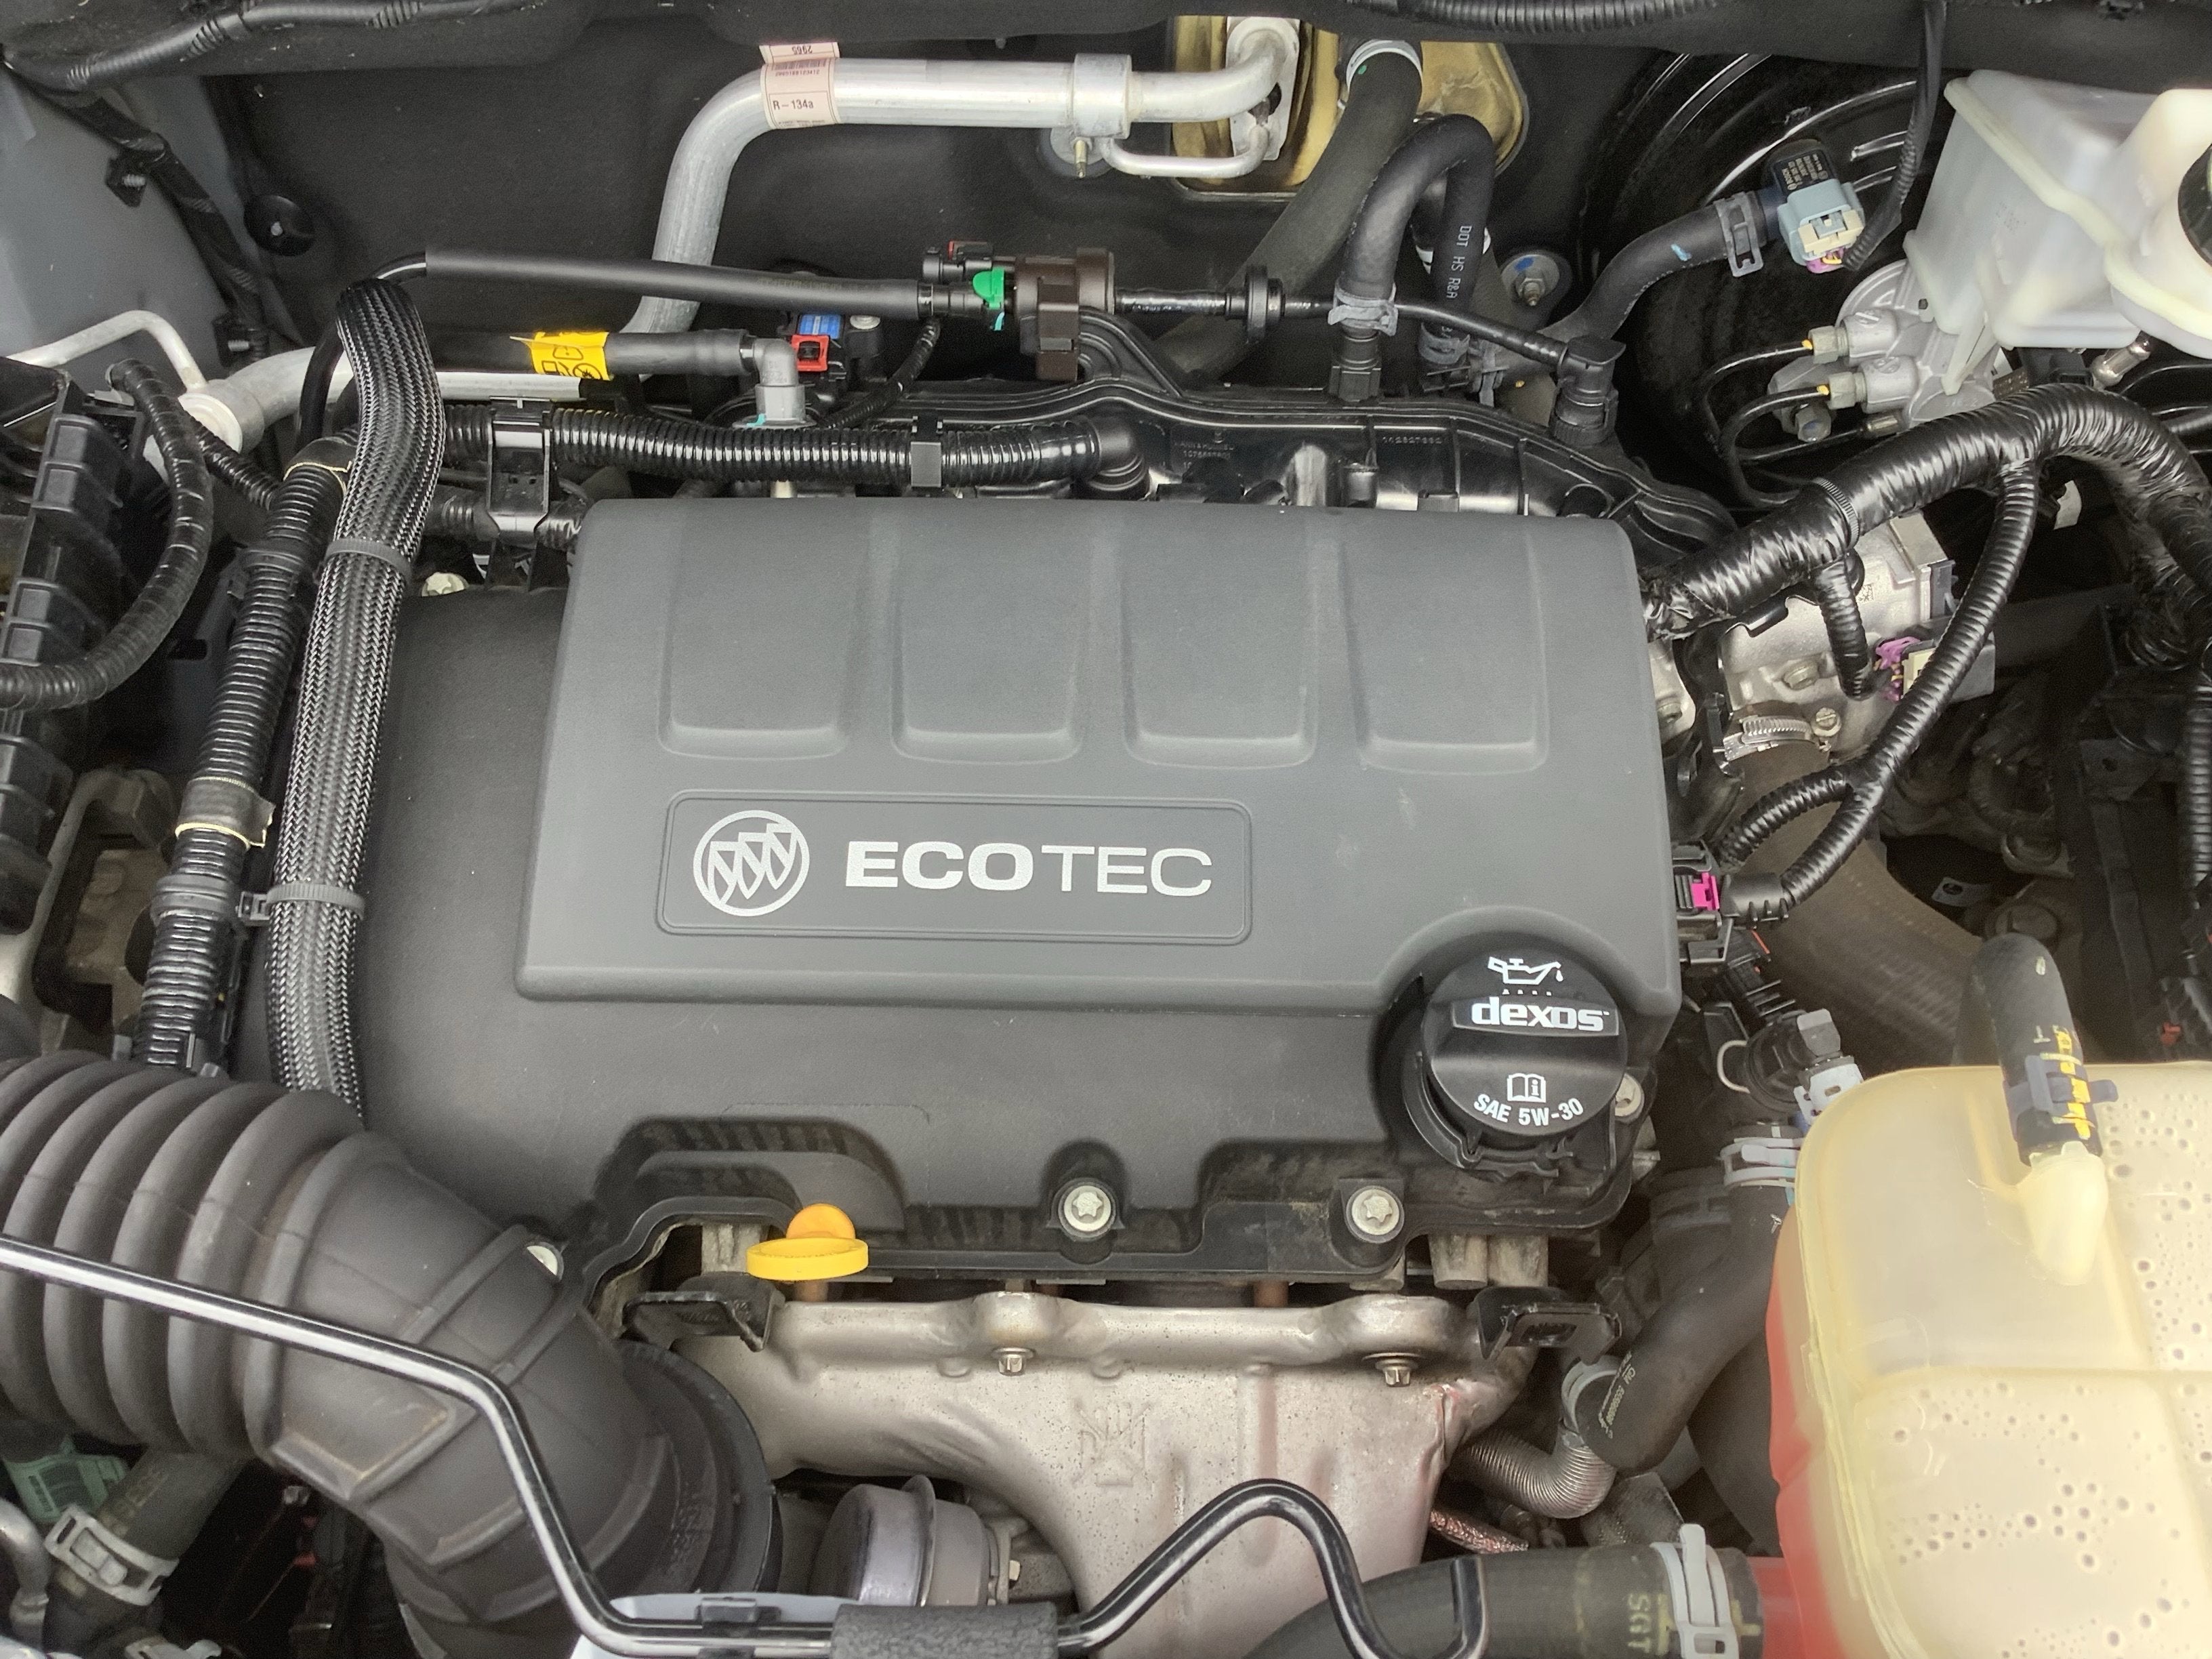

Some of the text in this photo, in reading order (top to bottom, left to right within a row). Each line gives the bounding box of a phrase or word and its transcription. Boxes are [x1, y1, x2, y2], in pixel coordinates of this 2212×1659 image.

[1446, 225, 1472, 299] DOT HS R&A
[845, 840, 1213, 897] ECOTEC
[1471, 996, 1604, 1031] dexos
[1473, 1093, 1584, 1126] SAE 5W-30
[1623, 1366, 1636, 1385] GM
